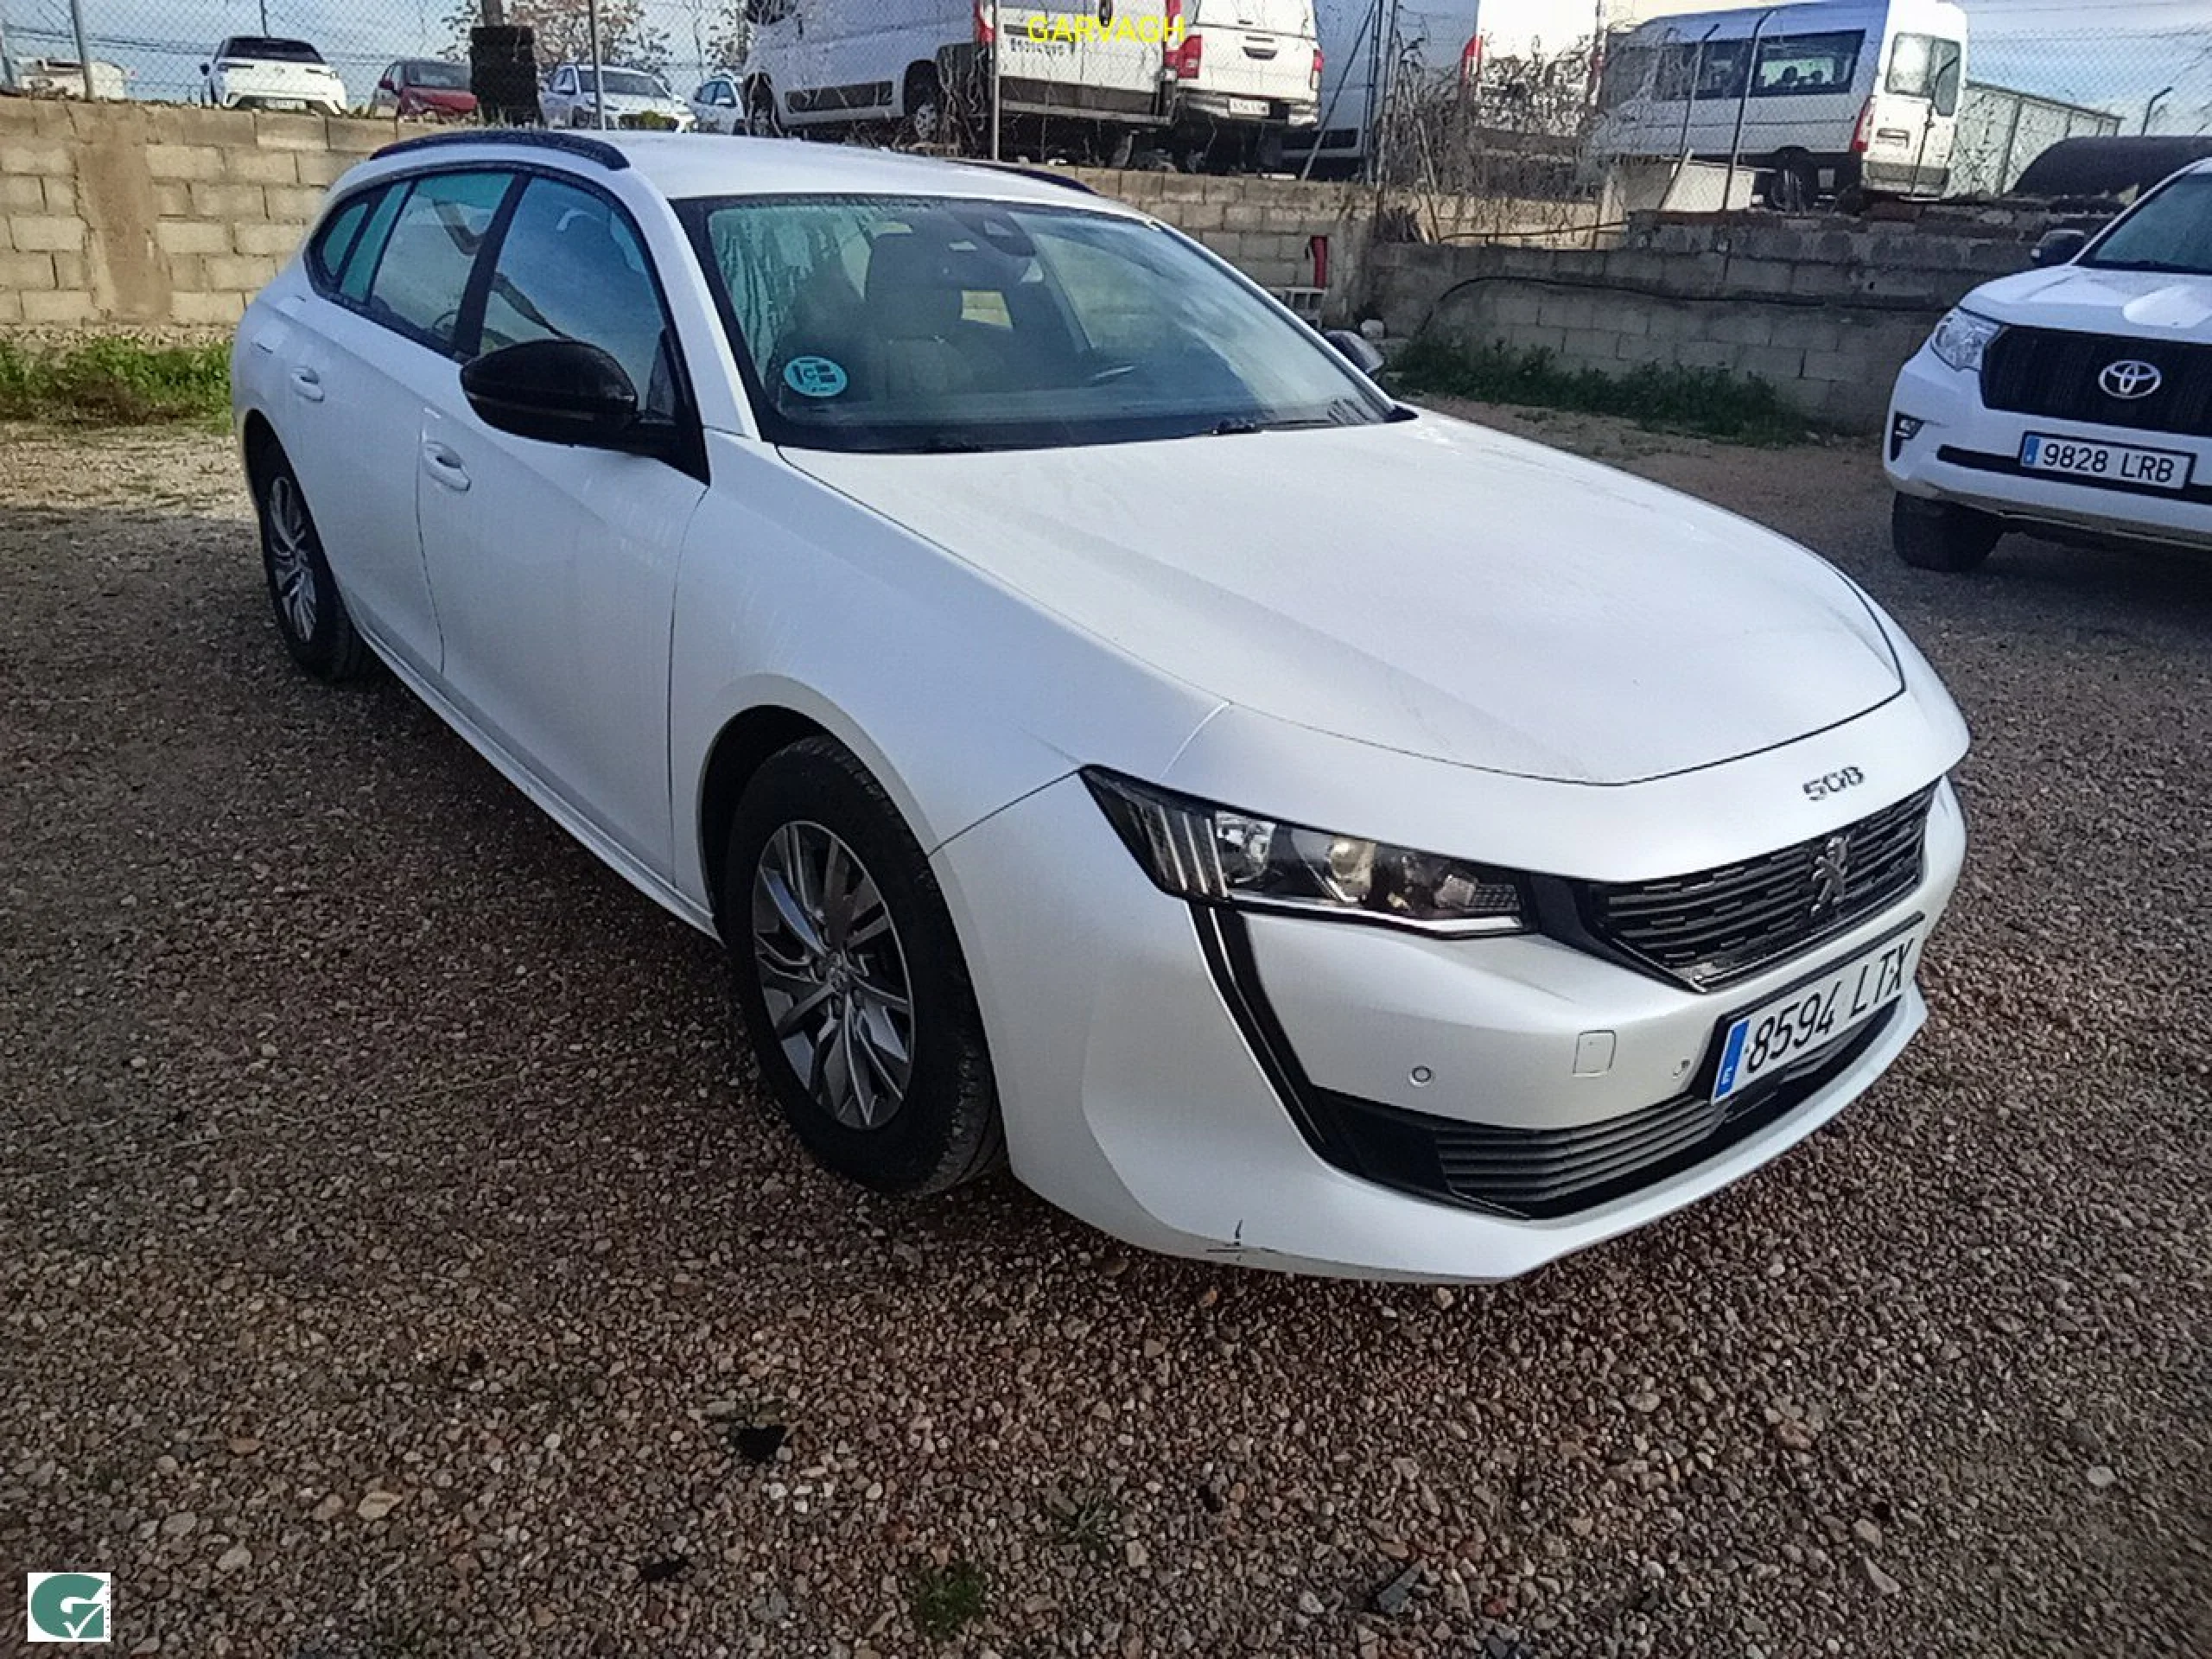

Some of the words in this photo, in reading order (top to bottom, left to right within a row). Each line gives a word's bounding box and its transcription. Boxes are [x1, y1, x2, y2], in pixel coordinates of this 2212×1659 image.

[2044, 442, 2108, 473] 9828
[2120, 453, 2175, 483] LRB
[1802, 766, 1863, 800] 508
[1747, 981, 1842, 1073] 8594
[1849, 938, 1914, 1018] LTX
